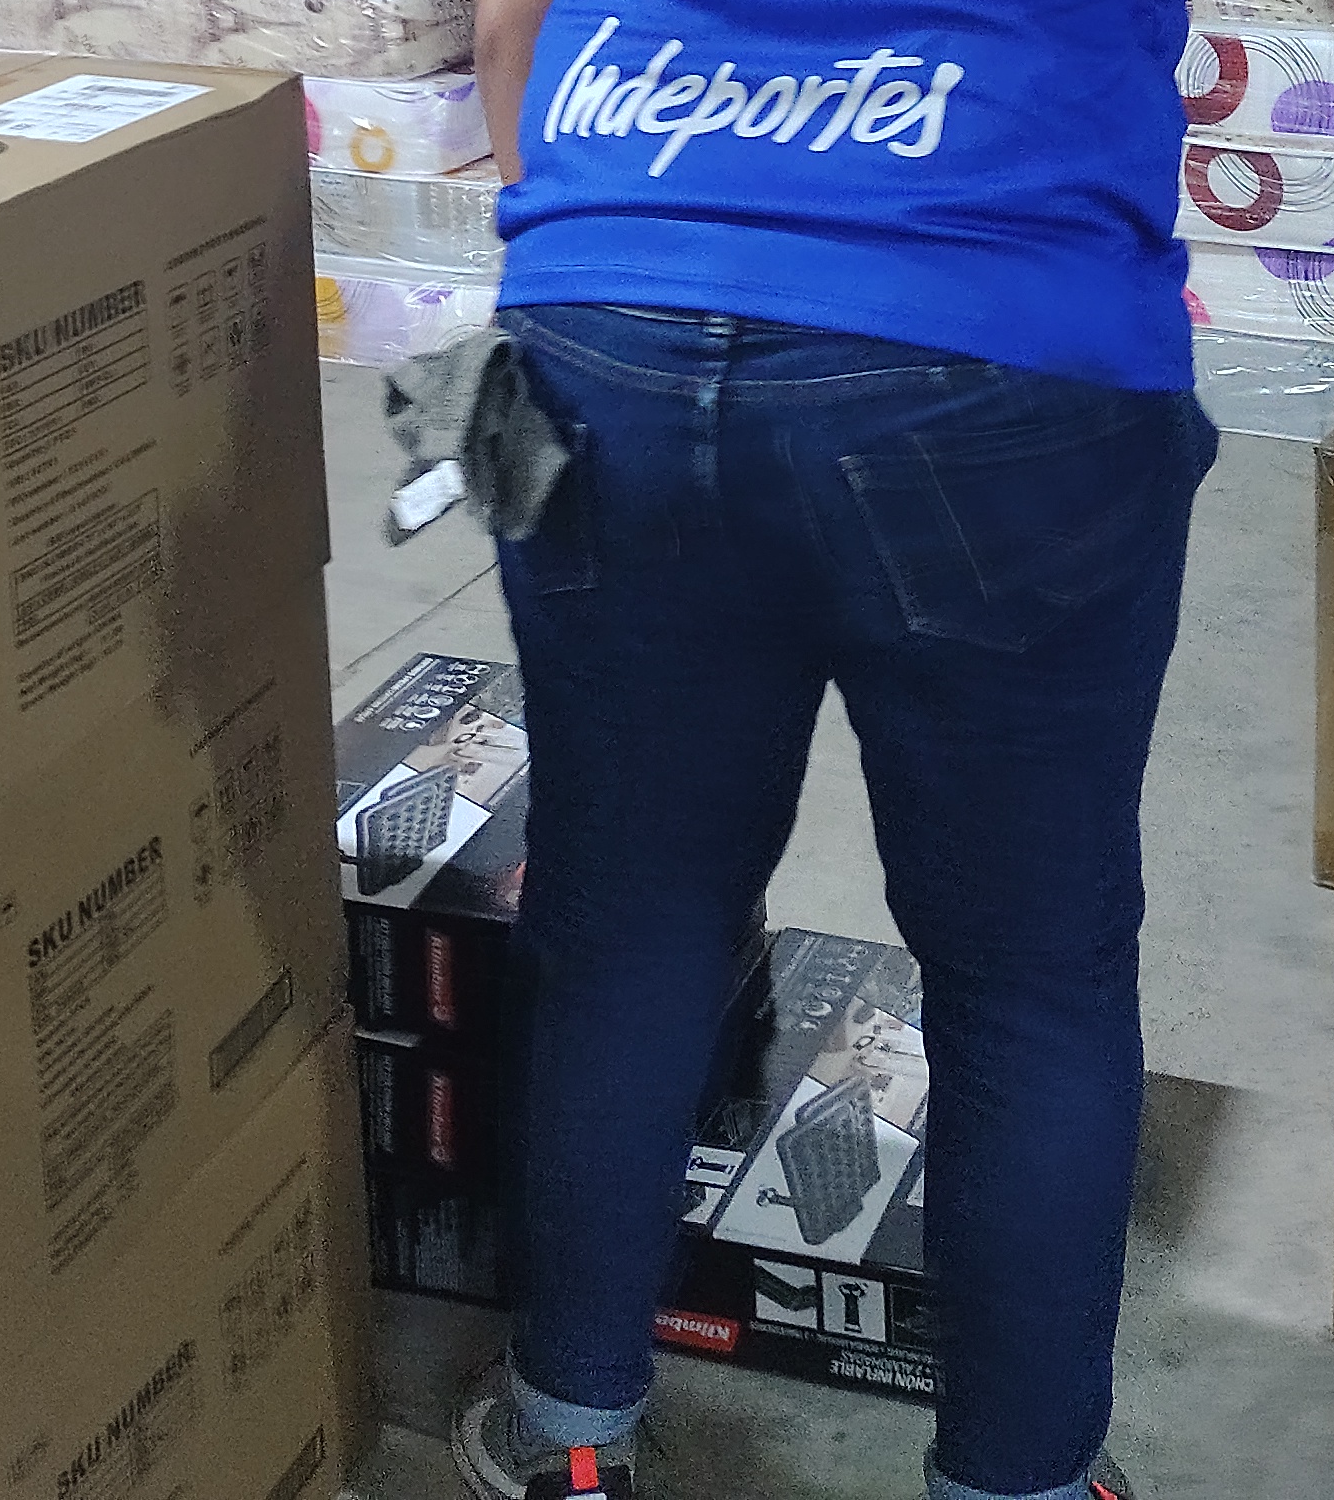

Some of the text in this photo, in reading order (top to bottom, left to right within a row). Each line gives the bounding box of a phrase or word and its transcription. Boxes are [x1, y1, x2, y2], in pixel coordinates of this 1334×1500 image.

[543, 16, 965, 178] Indeportes
[55, 280, 147, 346] NUMBER
[28, 836, 163, 968] SKU NUMBER
[107, 1338, 197, 1448] NUMBER
